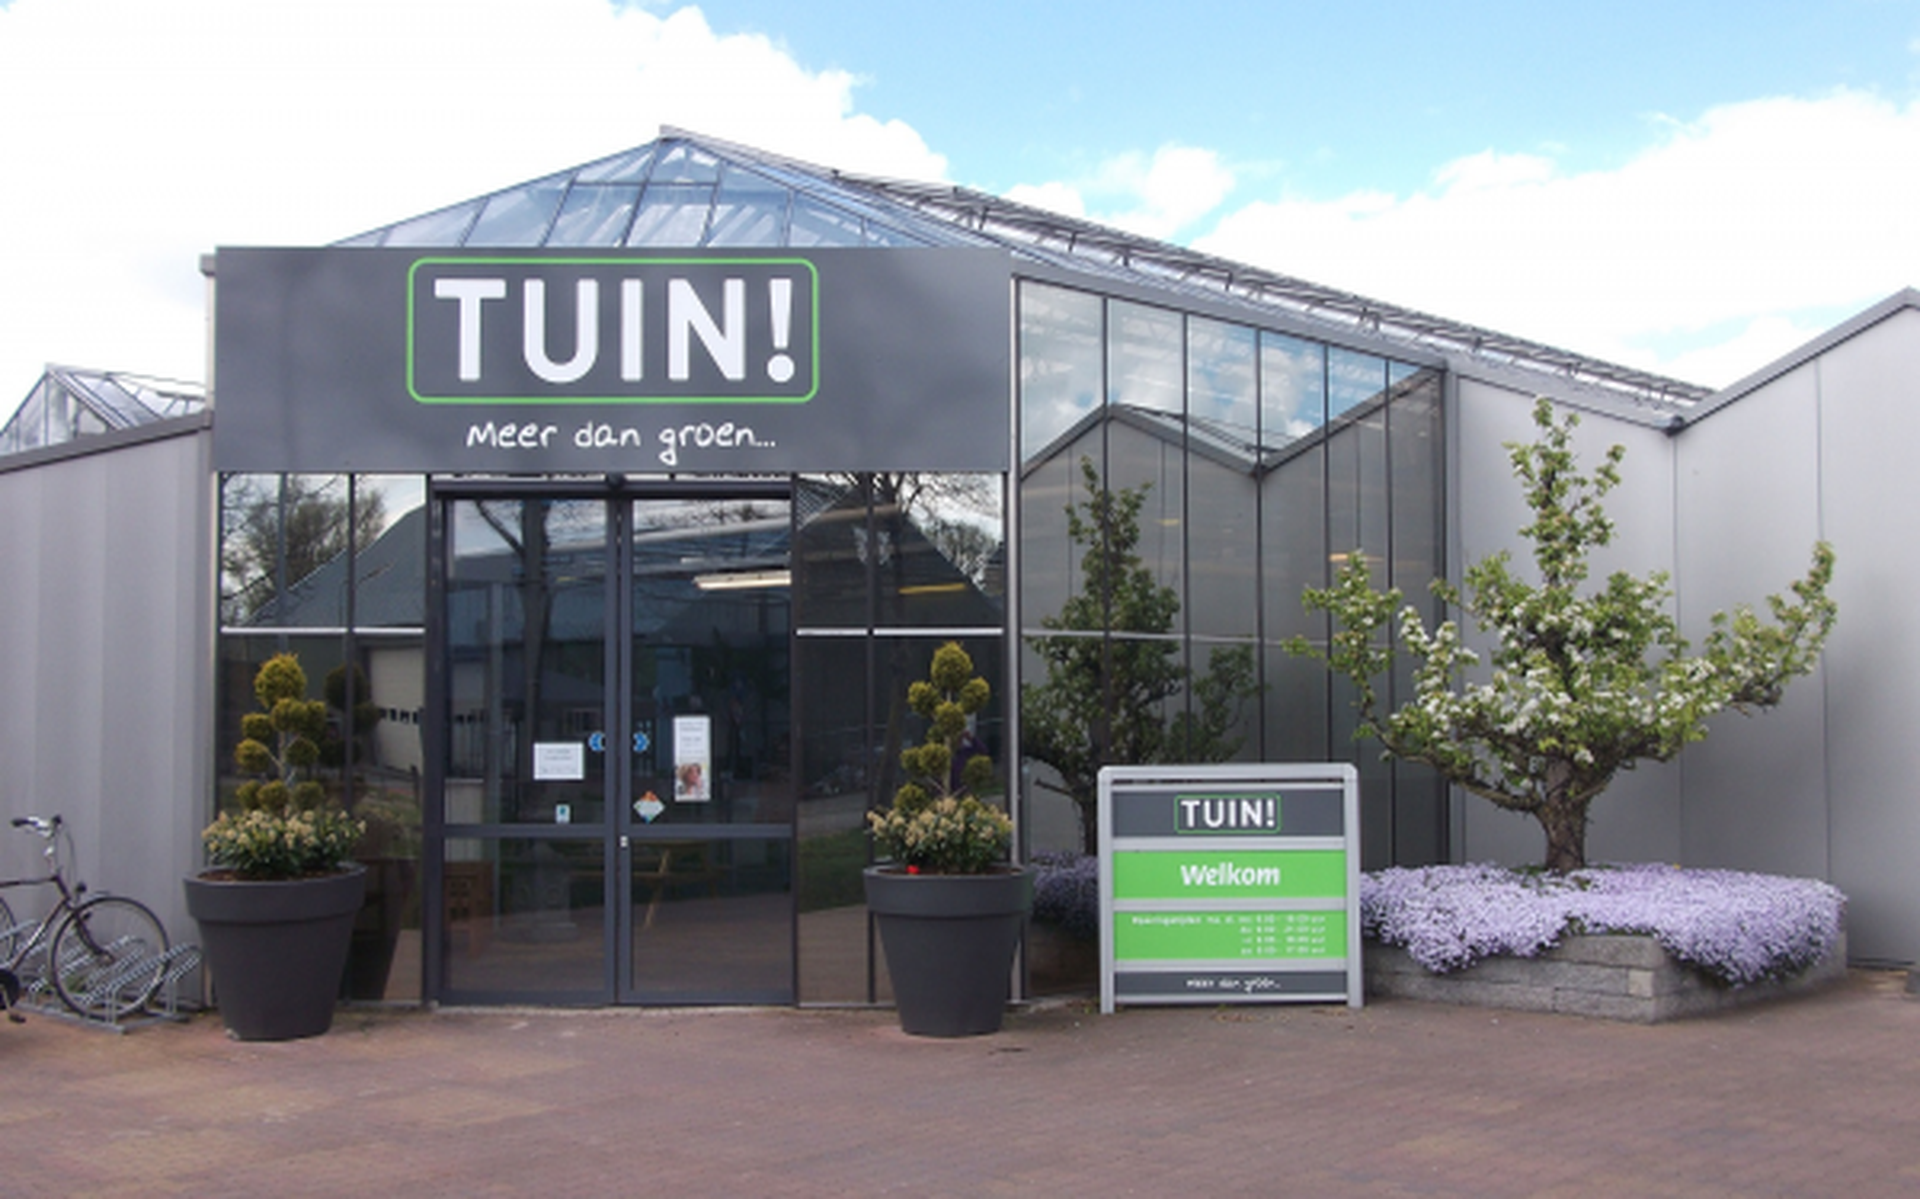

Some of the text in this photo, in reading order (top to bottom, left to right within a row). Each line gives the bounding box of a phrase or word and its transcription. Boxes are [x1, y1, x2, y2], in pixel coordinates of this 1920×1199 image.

[434, 278, 795, 383] TUIN!
[466, 421, 776, 467] Meer dan groen...
[1180, 798, 1275, 828] TUIN!
[1180, 861, 1281, 887] Welkom
